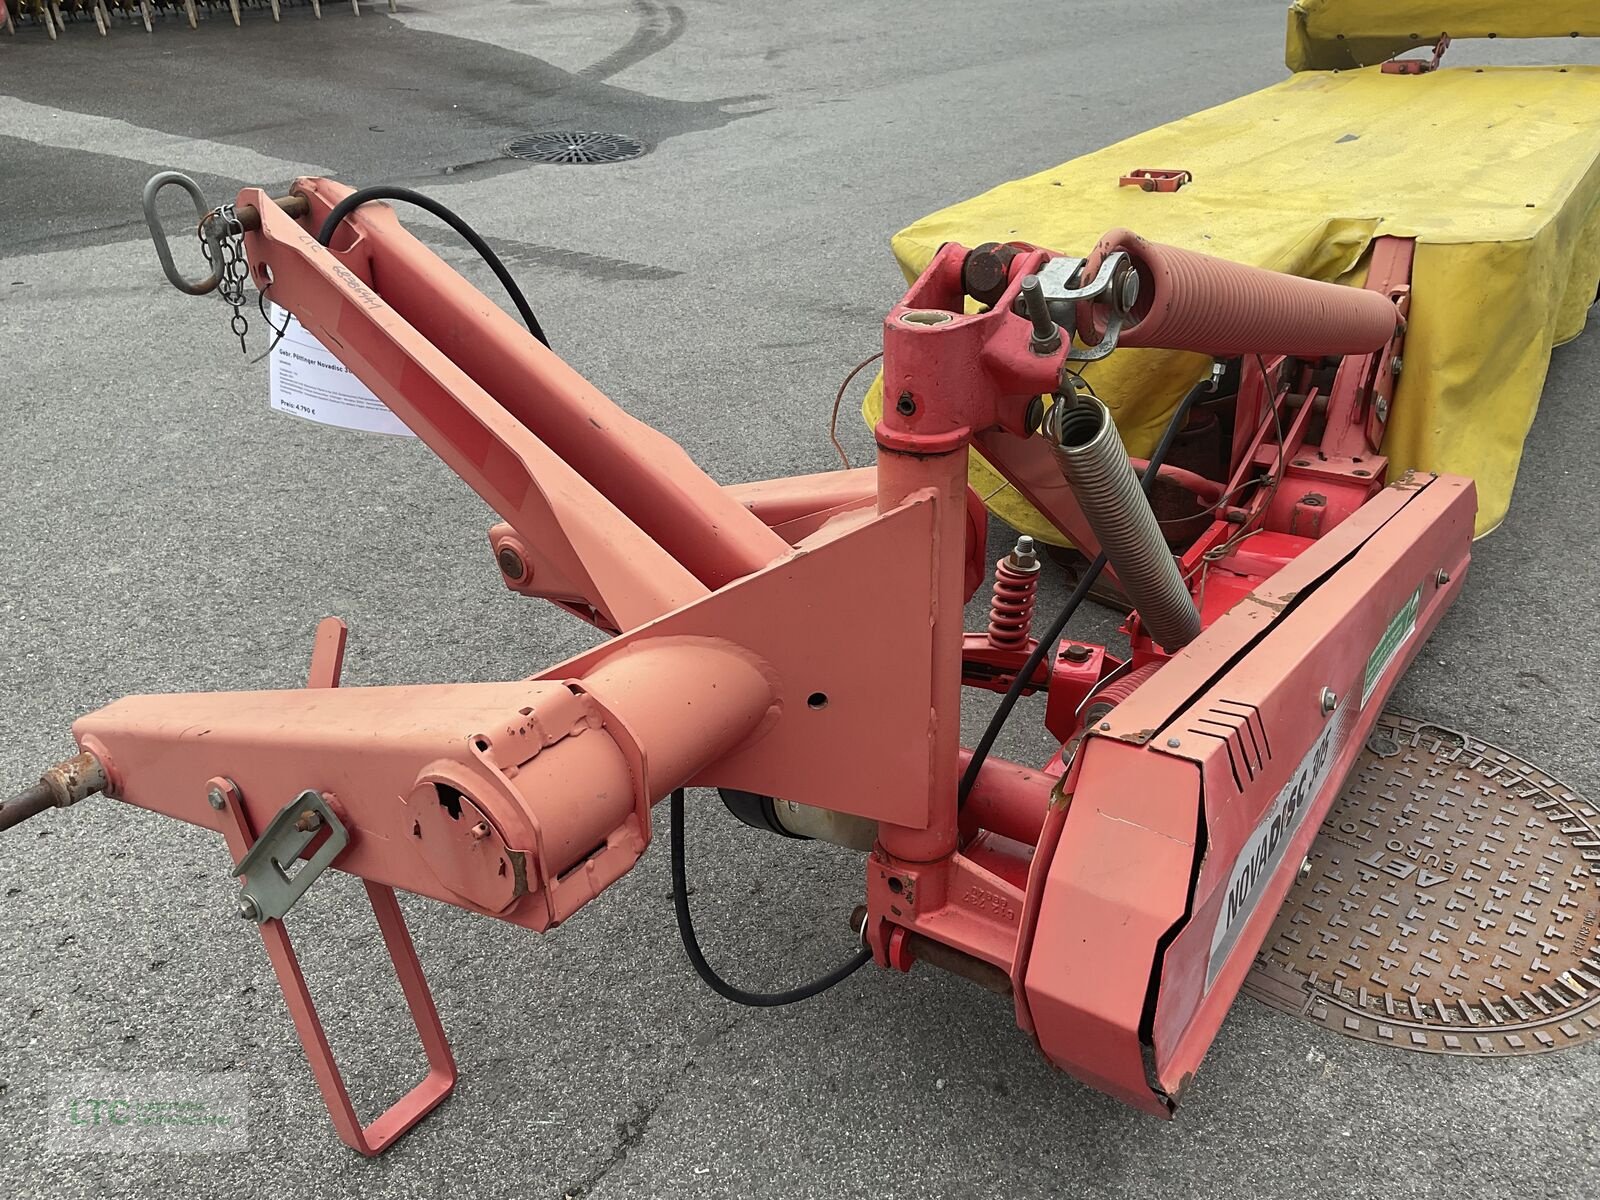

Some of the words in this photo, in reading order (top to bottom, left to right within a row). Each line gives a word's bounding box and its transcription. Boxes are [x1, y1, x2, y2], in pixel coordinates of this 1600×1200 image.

[317, 360, 343, 373] Novadisc
[280, 399, 294, 409] Preis:
[1227, 768, 1307, 930] NOVADISC
[1385, 838, 1458, 875] EURO
[1354, 850, 1450, 888] AET
